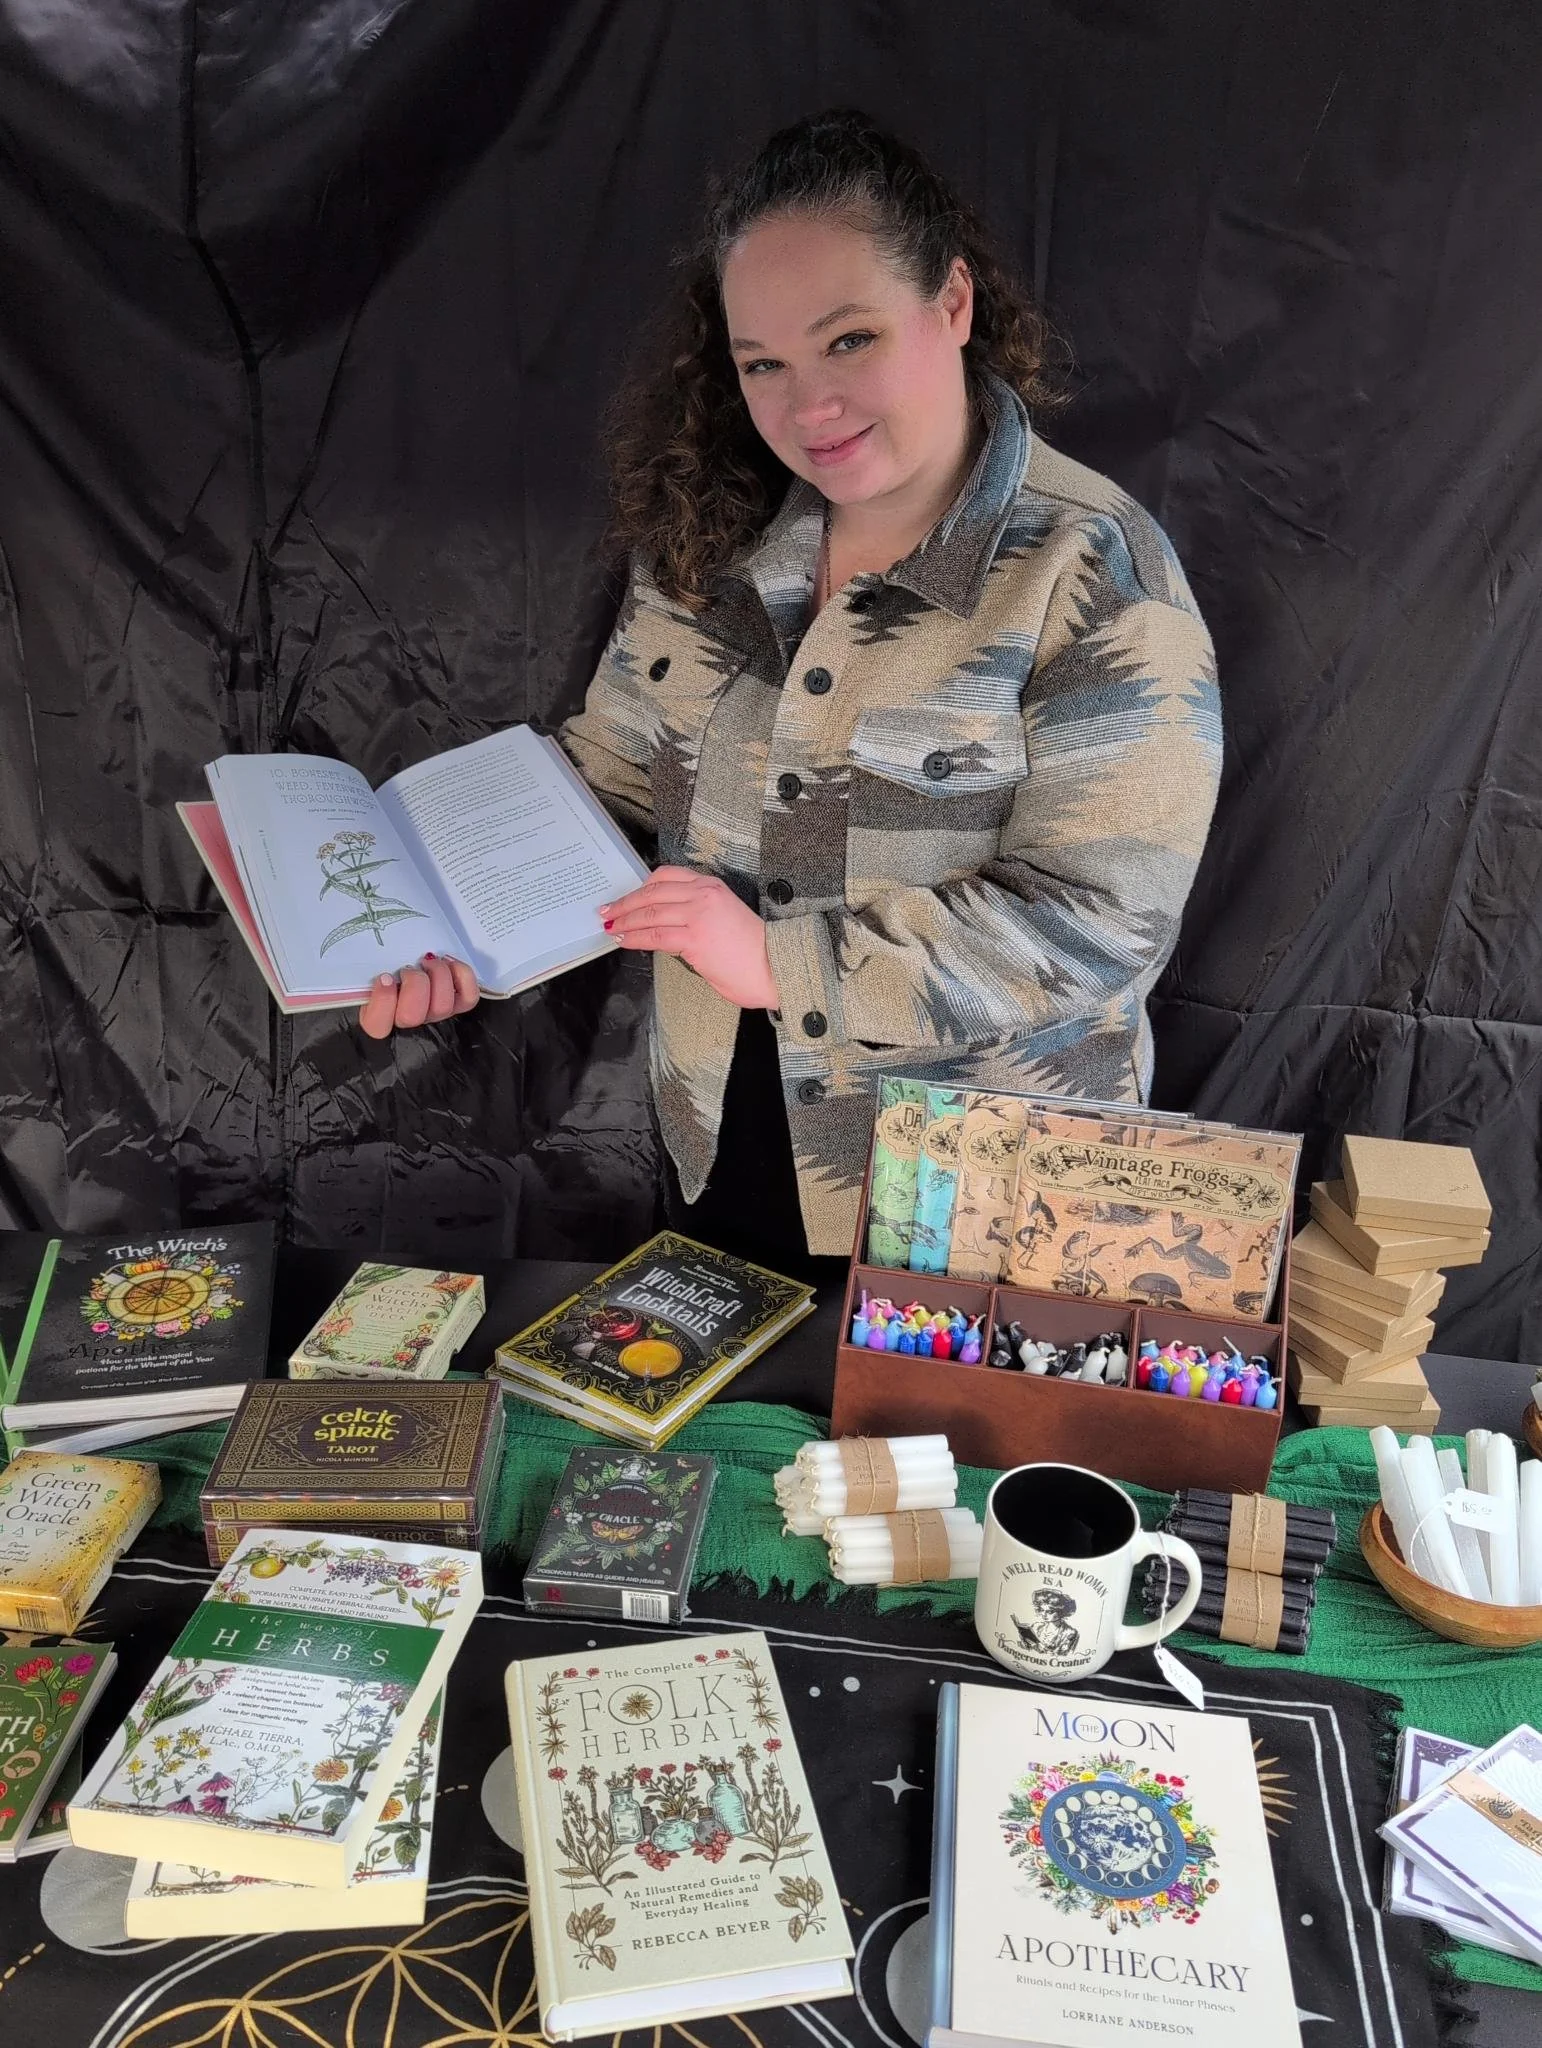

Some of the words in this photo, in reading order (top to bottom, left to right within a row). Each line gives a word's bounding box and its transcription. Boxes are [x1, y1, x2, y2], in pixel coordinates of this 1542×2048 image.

[1084, 1148, 1163, 1178] Vintage
[1169, 1160, 1230, 1190] Frogs
[1134, 1176, 1152, 1187] FLAT
[107, 1245, 154, 1261] The
[157, 1237, 228, 1253] Witch's
[381, 1285, 430, 1299] Green
[640, 1266, 744, 1319] WitchCraft
[617, 1283, 720, 1337] Cocktails
[75, 1365, 108, 1375] potions
[109, 1364, 124, 1373] for
[124, 1363, 139, 1371] the
[139, 1360, 168, 1369] Wheel
[168, 1359, 181, 1367] of
[180, 1357, 194, 1365] the
[194, 1356, 215, 1364] Year
[100, 1358, 123, 1366] How
[135, 1354, 158, 1362] make
[159, 1350, 193, 1360] magical
[321, 1407, 402, 1426] celtic
[314, 1423, 400, 1441] spirit
[326, 1445, 379, 1454] TAROT
[31, 1472, 101, 1493] Green
[20, 1488, 93, 1511] Witch
[6, 1504, 80, 1526] Oracle
[599, 1513, 641, 1524] ORACLE
[537, 1568, 572, 1577] POISONOUS
[572, 1570, 595, 1579] PLANTS
[603, 1574, 625, 1582] GUIDES
[625, 1576, 640, 1584] AND
[1000, 1571, 1010, 1583] A
[1005, 1562, 1037, 1577] WELL
[1038, 1563, 1073, 1578] READ
[1076, 1570, 1109, 1598] WOMAN
[1043, 1576, 1053, 1586] IS
[1055, 1579, 1064, 1588] A
[249, 1590, 300, 1601] INFORMATION
[308, 1596, 336, 1606] SIMPLE
[336, 1599, 364, 1610] HERBAL
[289, 1585, 327, 1595] COMPLETE,
[328, 1590, 375, 1601] EASY-TO-USE
[272, 1600, 307, 1610] NATURAL
[308, 1604, 339, 1614] HEALTH
[339, 1608, 356, 1617] AND
[355, 1610, 389, 1620] HEALING
[250, 1615, 283, 1626] the
[299, 1621, 340, 1635] way
[355, 1629, 378, 1641] of
[211, 1627, 391, 1667] HERBS
[997, 1638, 1048, 1668] Dangerous
[1048, 1656, 1092, 1668] Creature
[605, 1669, 629, 1680] The
[634, 1661, 695, 1676] Complete
[231, 1691, 256, 1700] revised
[256, 1694, 283, 1704] chapter
[292, 1699, 324, 1709] botanical
[265, 1687, 287, 1696] newest
[288, 1690, 308, 1698] herbs
[574, 1673, 738, 1733] FOLK
[222, 1707, 239, 1715] Uses
[251, 1711, 281, 1721] magnetic
[282, 1715, 308, 1725] therapy
[237, 1701, 260, 1709] cancer
[260, 1704, 298, 1714] treatments
[197, 1723, 254, 1739] MICHAEL
[258, 1731, 305, 1747] TIERRA,
[581, 1716, 748, 1759] HERBAL
[1032, 1707, 1176, 1753] MOON
[1079, 1724, 1100, 1734] THE
[209, 1736, 241, 1750] L.Ac.,
[244, 1741, 282, 1754] O.M.D.
[623, 1889, 640, 1900] An
[645, 1879, 706, 1896] Illustrated
[710, 1874, 746, 1886] Guide
[749, 1873, 761, 1881] to
[630, 1895, 675, 1911] Natural
[679, 1887, 734, 1903] Remedies
[738, 1883, 760, 1894] and
[645, 1905, 699, 1921] Everyday
[703, 1898, 750, 1912] Healing
[632, 1929, 710, 1950] REBECCA
[716, 1919, 771, 1937] BEYER
[995, 1933, 1251, 1993] APOTHECARY
[1016, 1973, 1054, 1988] Rituals
[1055, 1980, 1077, 1992] and
[1079, 1983, 1123, 1999] Recipes
[1124, 1988, 1140, 2000] for
[1142, 1991, 1160, 2003] the
[1162, 1994, 1195, 2009] Lunar
[1197, 1998, 1236, 2014] Phases
[1062, 2008, 1124, 2026] LORRIANE
[1128, 2018, 1195, 2036] ANDERSON
